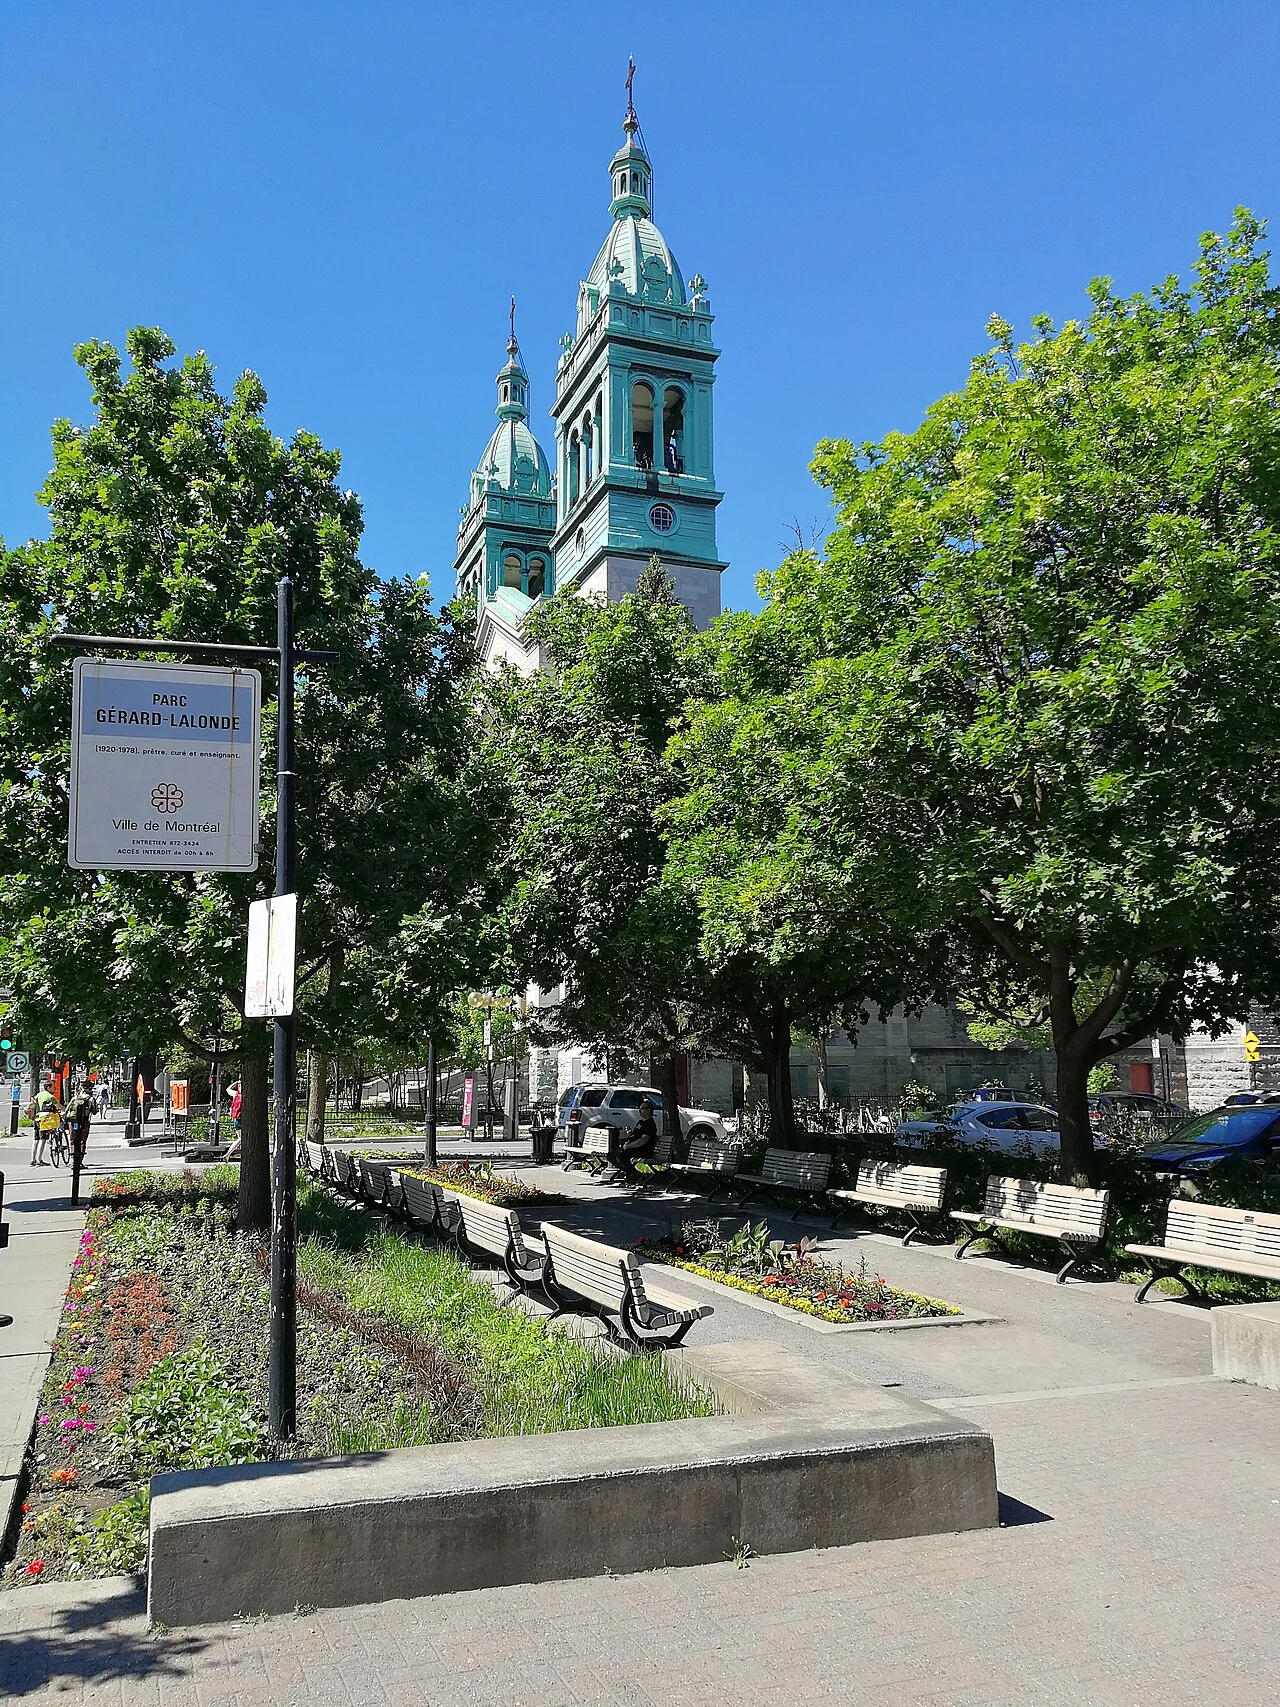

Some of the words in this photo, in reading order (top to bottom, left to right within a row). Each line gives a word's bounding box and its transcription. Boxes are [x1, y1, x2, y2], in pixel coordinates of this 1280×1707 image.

[152, 693, 188, 707] PARC
[96, 706, 240, 730] GÉRARD-LALONDE
[112, 819, 138, 830] Ville
[144, 820, 160, 831] de
[165, 820, 220, 833] Montréal
